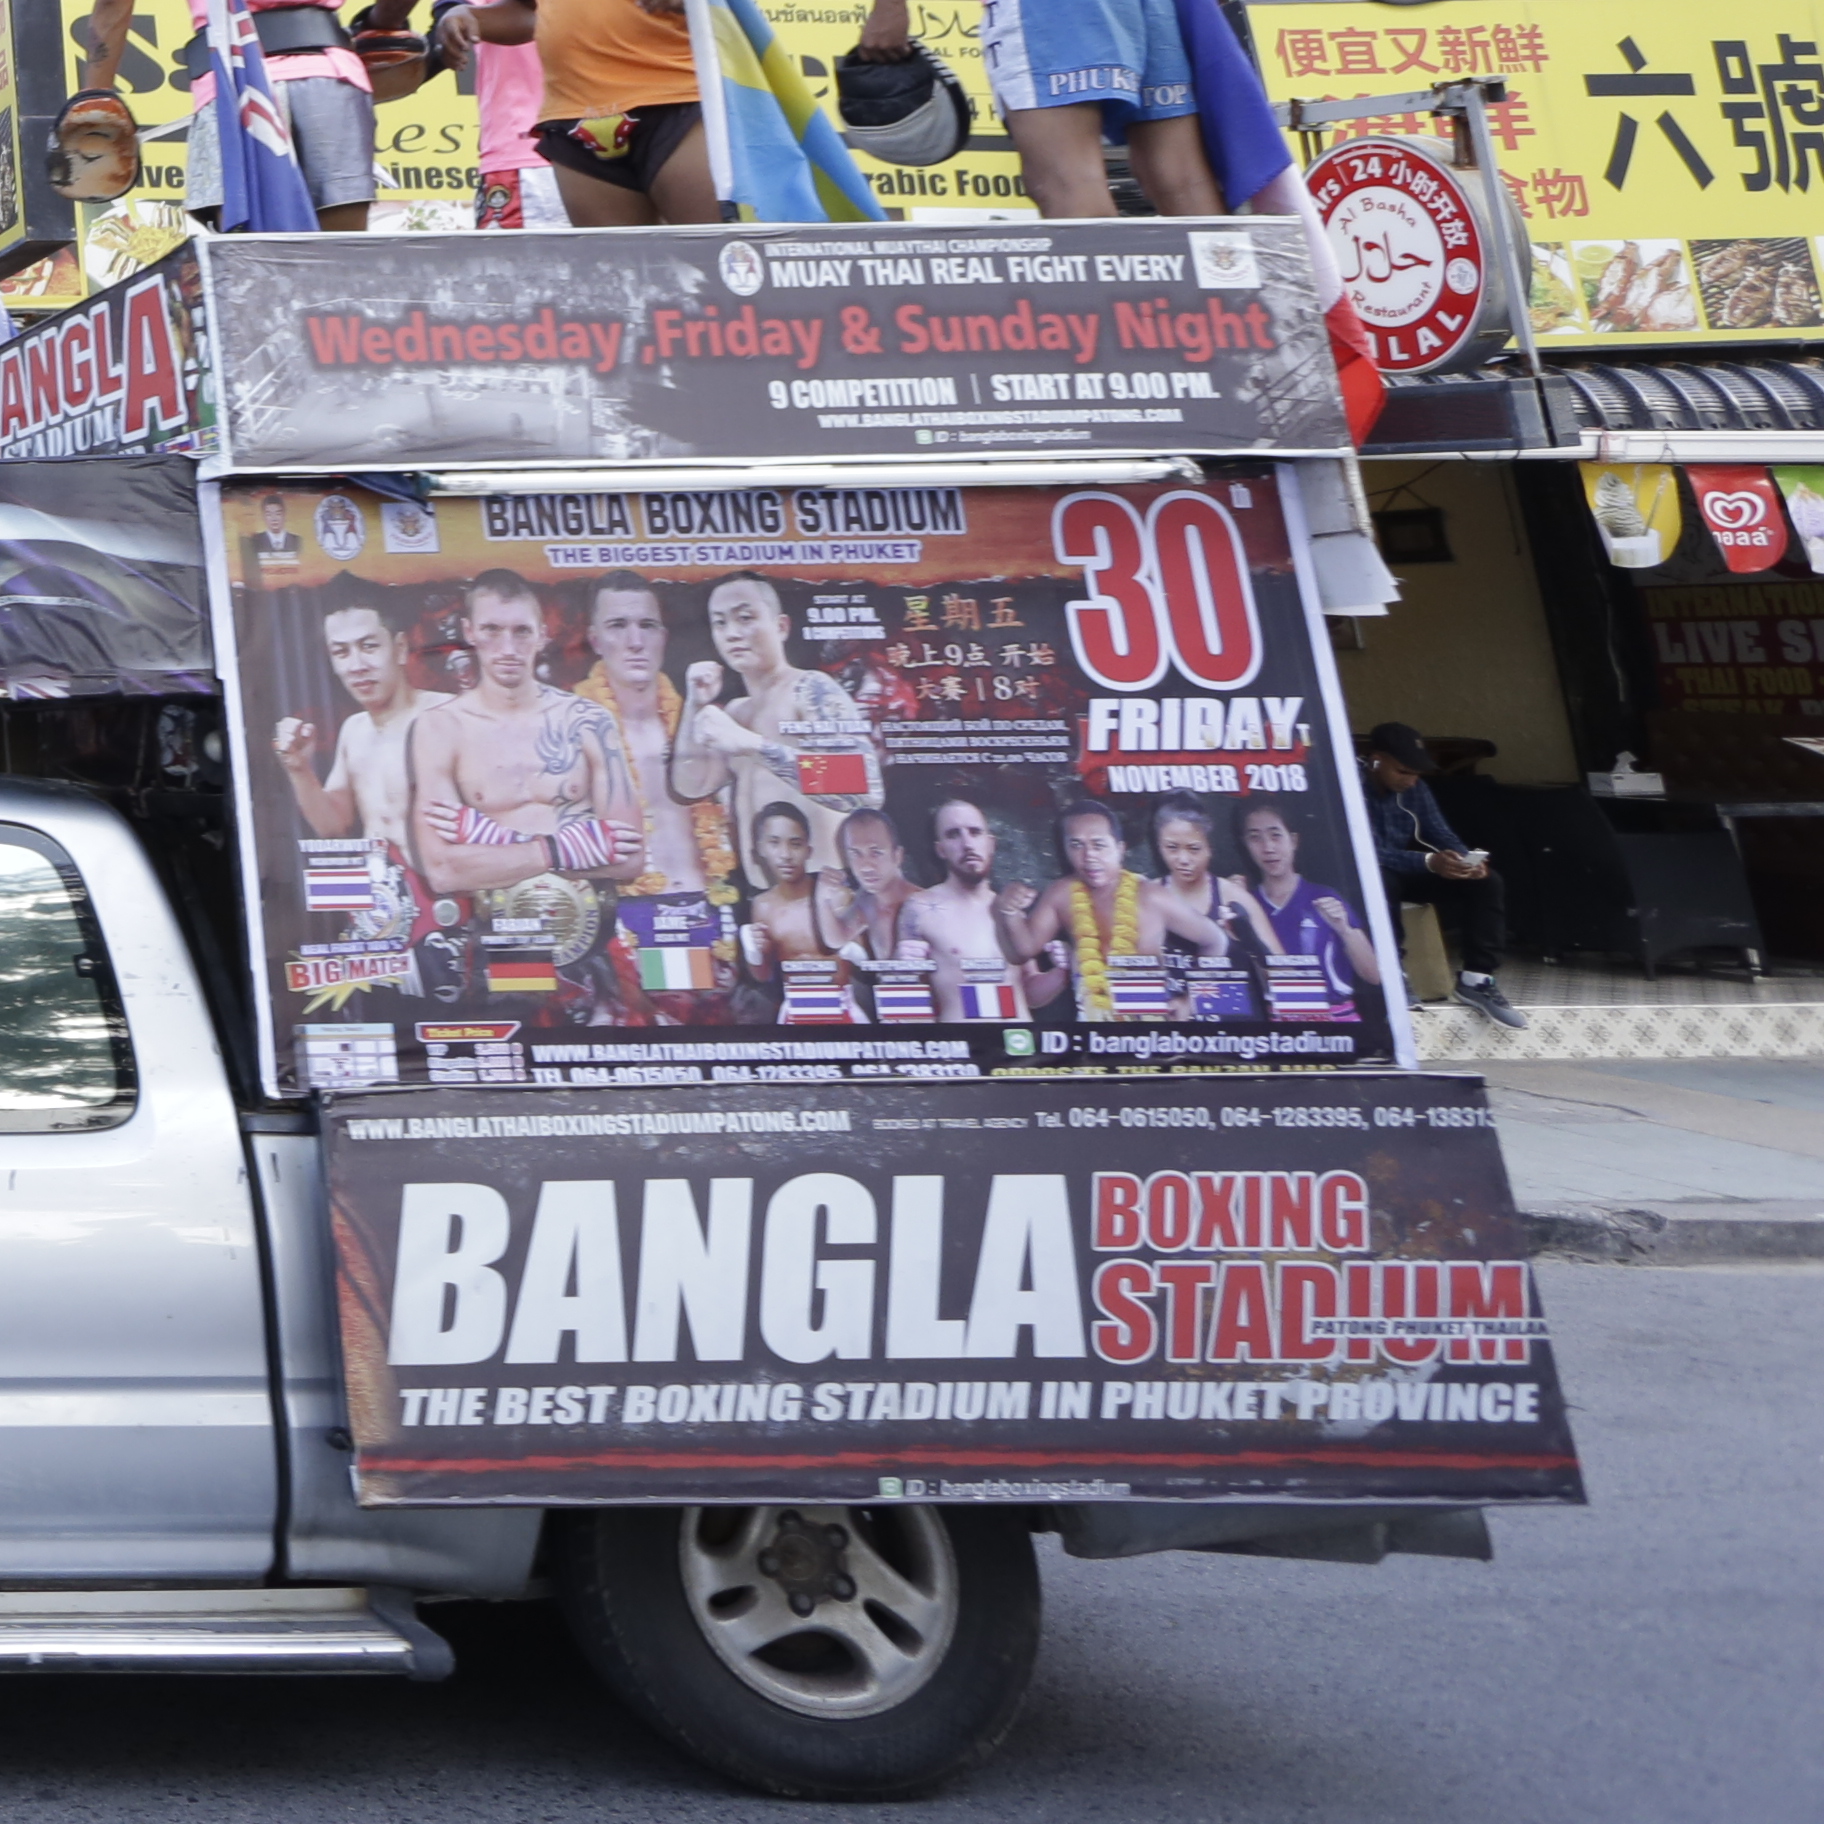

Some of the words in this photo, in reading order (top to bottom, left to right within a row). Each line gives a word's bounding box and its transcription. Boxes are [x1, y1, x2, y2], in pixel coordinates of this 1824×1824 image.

[1583, 33, 1824, 193] 六號
[1349, 156, 1383, 182] 24
[1339, 207, 1357, 235] Al
[1359, 197, 1417, 228] Basha
[1388, 159, 1469, 249] 小时开放
[764, 241, 873, 257] INTERNATIONAL
[948, 238, 1052, 254] CHAMPIONSHIP
[1343, 230, 1433, 283] حلال
[770, 259, 852, 288] MUAY
[858, 259, 925, 286] THAI
[931, 257, 1002, 284] REAL
[1008, 256, 1089, 283] FIGHT
[1097, 254, 1185, 283] EVERY
[1351, 281, 1433, 318] Restaurant
[308, 308, 620, 375] Wednesday
[841, 305, 884, 355] &
[896, 298, 1100, 364] Sunday
[1114, 296, 1274, 363] Night
[769, 380, 789, 408] 9
[791, 377, 956, 408] COMPETITION
[991, 373, 1073, 402] START
[1074, 373, 1104, 402] AT
[1109, 372, 1169, 401] 9.00
[1173, 372, 1221, 399] PM.
[483, 494, 634, 541] BANGLA
[645, 490, 788, 538] BOXING
[795, 488, 966, 535] STADIUM
[549, 546, 592, 567] THE
[598, 545, 691, 566] BIGGEST
[694, 543, 797, 564] STADIUM
[800, 542, 824, 564] IN
[829, 541, 921, 563] PHUKET
[807, 608, 845, 624] 9.00
[813, 595, 850, 606] START
[903, 594, 1026, 634] 星期五
[886, 643, 993, 669] 晚上9点
[998, 642, 1058, 667] 开始
[1653, 621, 1767, 663] LIVE
[916, 678, 967, 702] 大赛
[1675, 667, 1740, 695] THAI
[1743, 667, 1815, 695] FOOD
[1087, 696, 1304, 752] FRIDAY
[1108, 765, 1239, 795] NOVEMBER
[1245, 764, 1308, 793] 2018
[287, 959, 343, 991] BIG
[348, 954, 411, 983] MATCH
[1041, 1031, 1065, 1053] ID
[1090, 1030, 1355, 1059] banglaboxingstadium
[347, 1111, 850, 1141] WWW.BANGLATHAIBOXINGSTADIUMPATONG.COM
[1035, 1112, 1064, 1128] Tel.
[1068, 1108, 1215, 1131] 064-0615050,
[1221, 1107, 1367, 1131] 064-1283395,
[388, 1172, 1087, 1365] BANGLA
[1092, 1170, 1369, 1252] BOXING
[1091, 1258, 1531, 1365] STADIUM
[1311, 1319, 1387, 1337] PATONG
[1393, 1319, 1467, 1336] PHUKET
[400, 1386, 488, 1426] THE
[493, 1385, 614, 1425] BEST
[621, 1383, 804, 1424] BOXING
[810, 1381, 1032, 1422] STADIUM
[1038, 1381, 1092, 1420] IN
[1099, 1381, 1286, 1420] PHUKET
[1294, 1381, 1540, 1423] PROVINCE
[905, 1479, 924, 1496] ID
